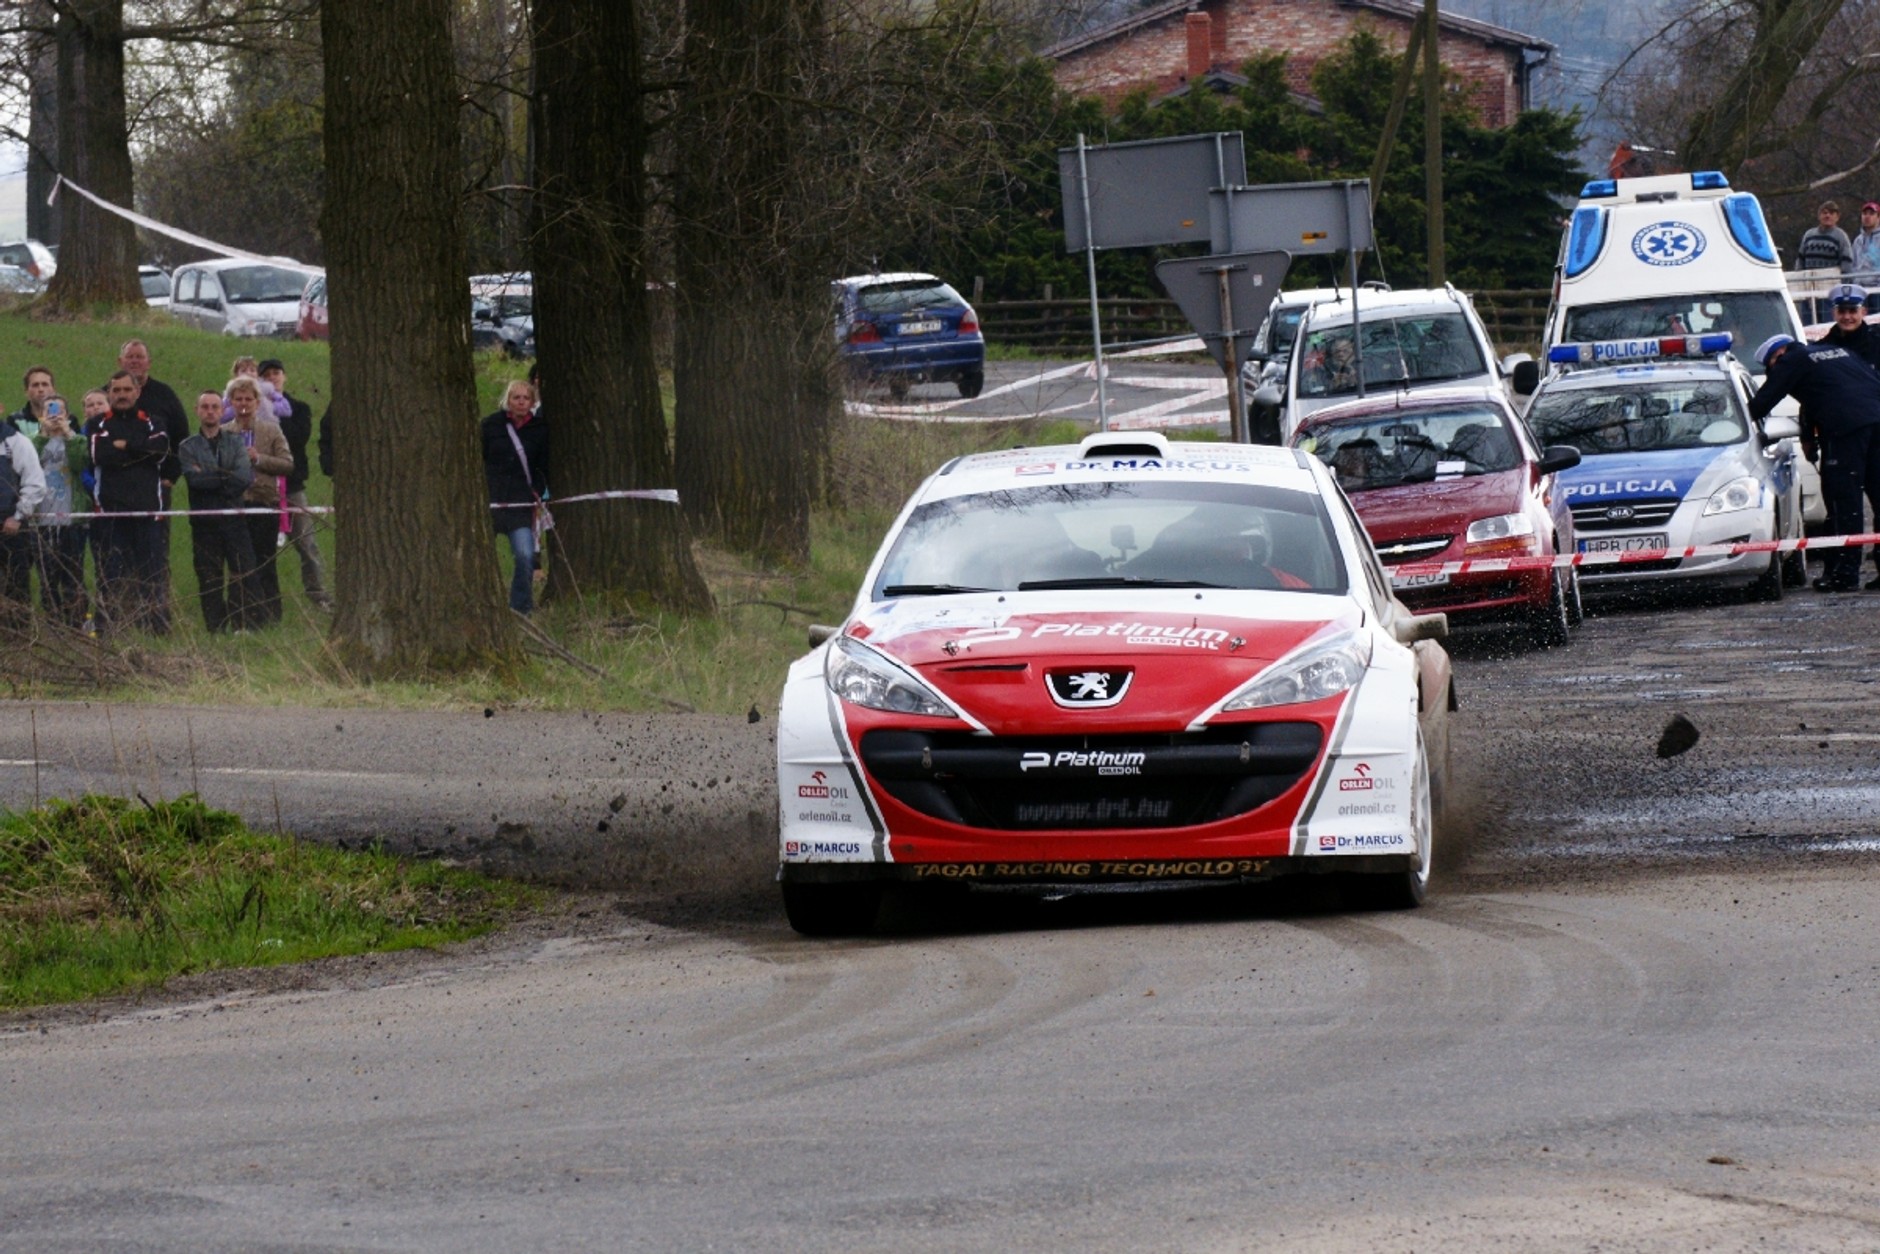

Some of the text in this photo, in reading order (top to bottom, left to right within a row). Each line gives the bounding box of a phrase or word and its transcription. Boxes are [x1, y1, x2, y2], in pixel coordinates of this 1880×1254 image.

[1595, 341, 1659, 361] POLICJA
[1111, 459, 1251, 473] MARCUS
[1563, 479, 1677, 498] POLICJA
[1031, 622, 1230, 642] Platinum
[1183, 640, 1220, 651] OIL
[1054, 751, 1145, 766] Platinum
[1125, 767, 1142, 775] OIL
[1341, 778, 1396, 790] ORLEN OIL
[800, 786, 849, 799] ORLEN OIL
[1338, 803, 1397, 816] orlenoil.cz
[799, 810, 853, 823] orlenoil.cz
[1355, 834, 1404, 846] MARCUS
[814, 843, 860, 853] MARCUS
[992, 862, 1091, 876] RACING
[1099, 860, 1270, 876] TECHNOLOGY
